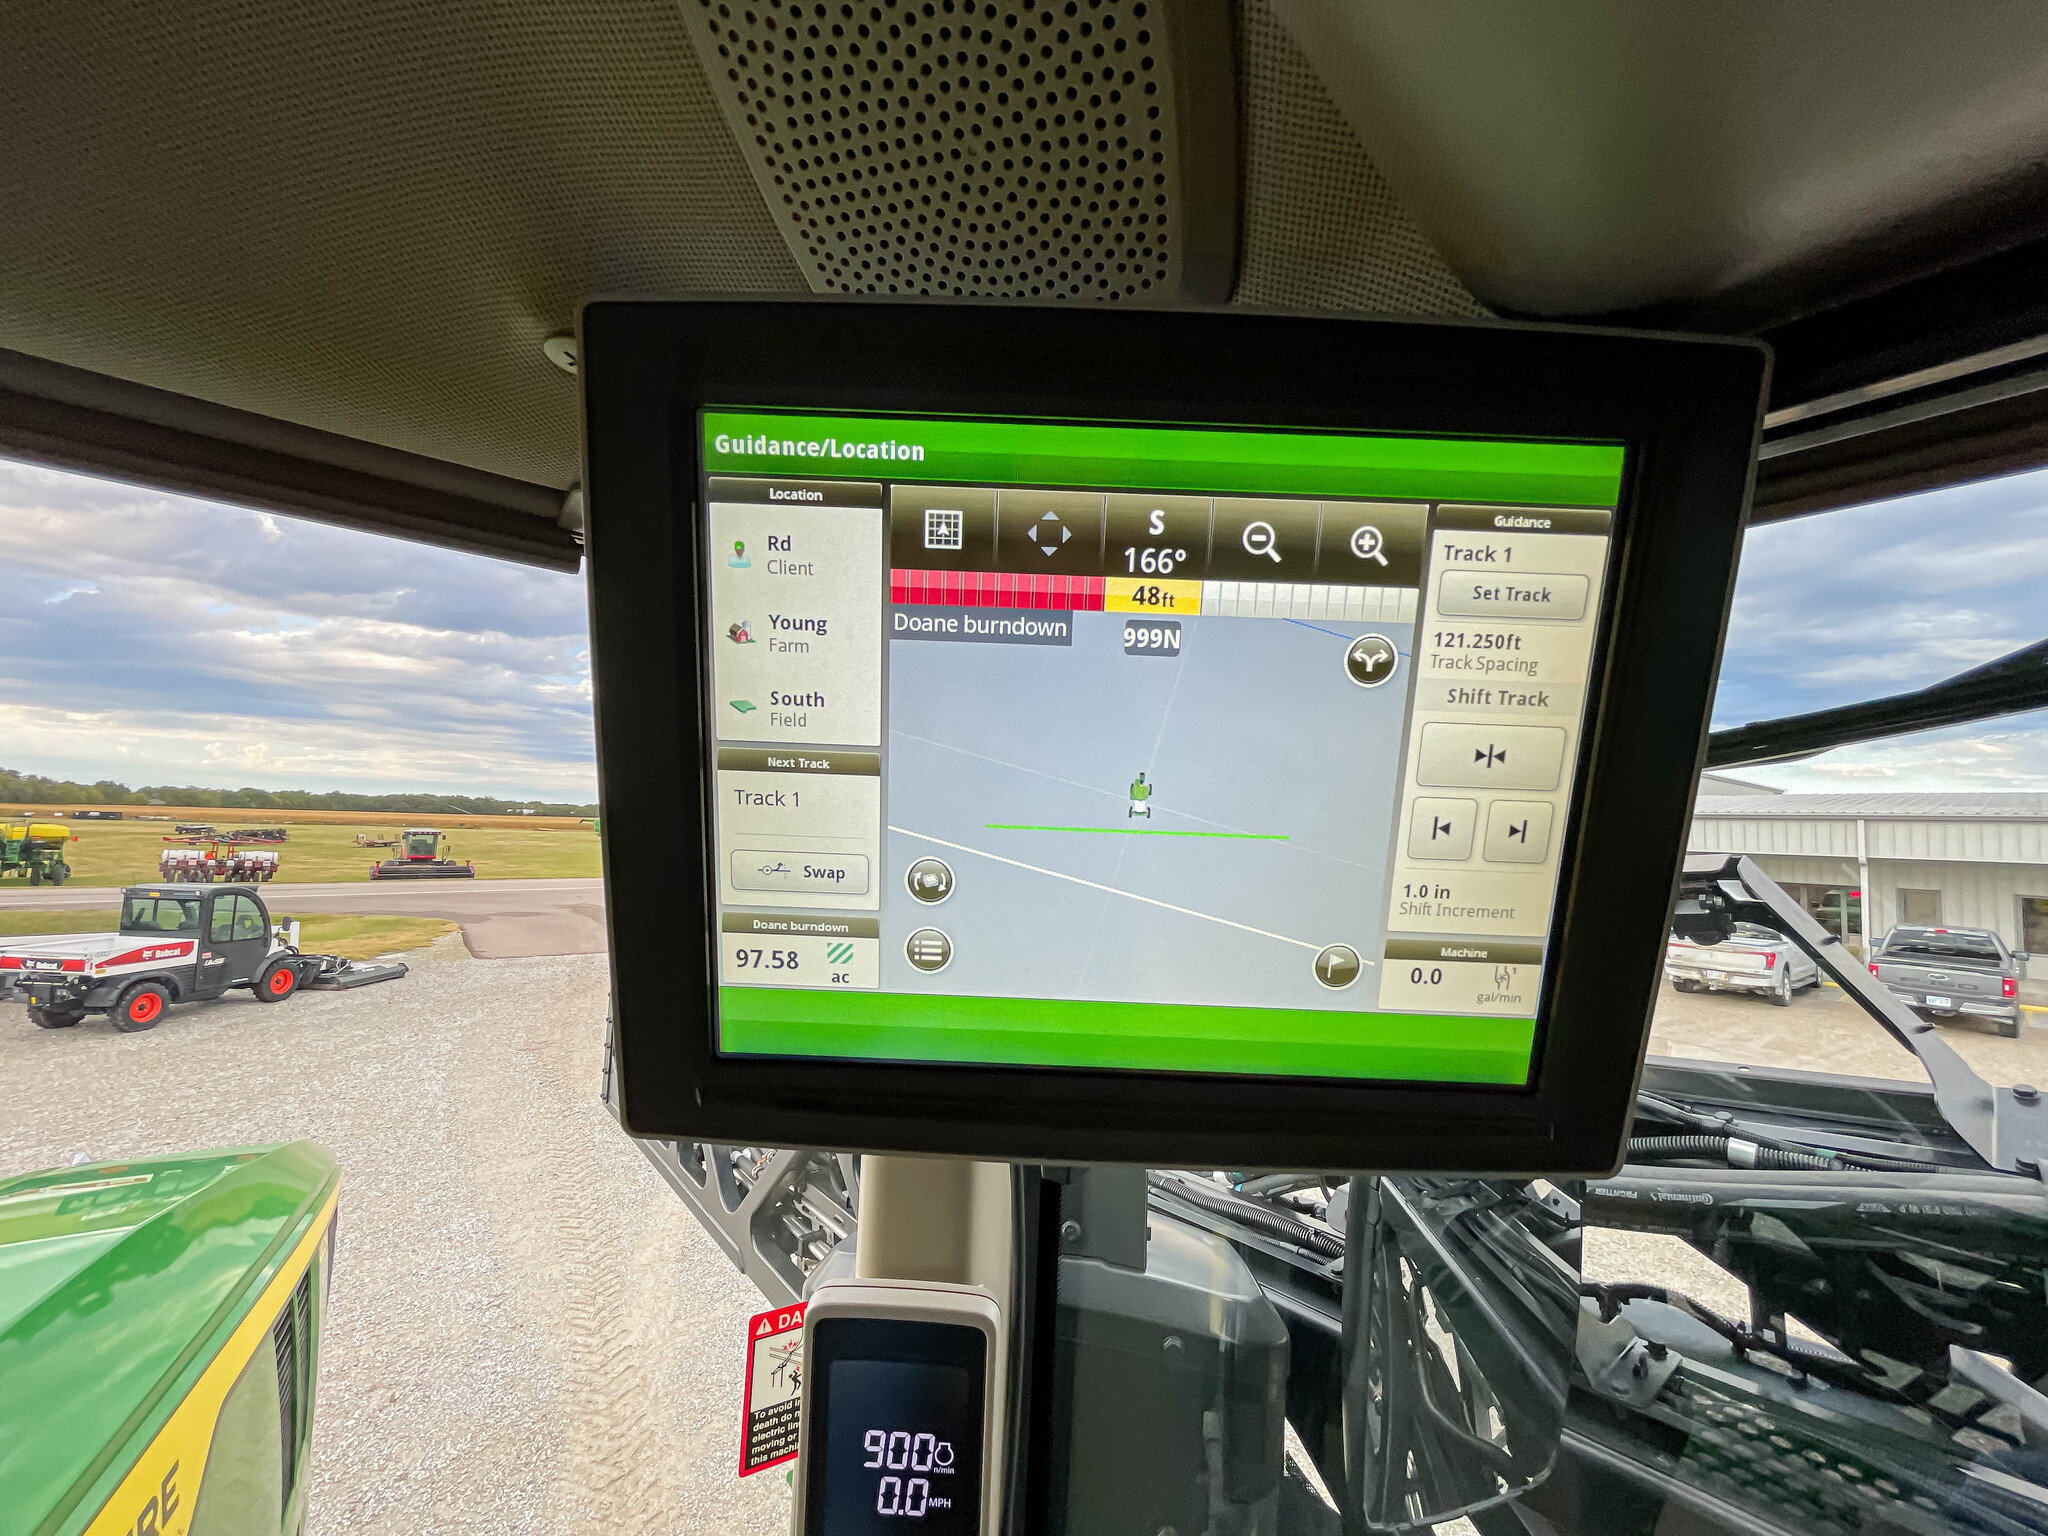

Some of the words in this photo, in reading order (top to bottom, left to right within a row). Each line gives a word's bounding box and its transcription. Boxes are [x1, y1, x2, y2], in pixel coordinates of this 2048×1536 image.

[714, 433, 925, 462] Guidance/Location
[769, 488, 823, 502] Location
[1148, 509, 1165, 536] S
[1494, 515, 1552, 530] Guidance
[768, 535, 792, 553] Rd
[1124, 547, 1186, 575] 166°
[1444, 544, 1497, 564] Track
[1504, 547, 1512, 563] 1
[767, 559, 814, 577] Client
[1473, 585, 1500, 601] Set
[1506, 586, 1552, 603] Track
[769, 614, 828, 636] Young
[894, 612, 959, 635] Doane
[964, 615, 1067, 638] burndown
[769, 638, 810, 655] Farm
[1124, 627, 1181, 651] 999N
[1434, 632, 1522, 651] 121.250ft
[1431, 654, 1473, 671] Track
[1475, 657, 1539, 677] Spacing
[770, 691, 825, 709] South
[1447, 688, 1492, 706] Shift
[1498, 690, 1550, 708] Track
[770, 712, 808, 729] Field
[768, 756, 795, 769] Next
[799, 758, 830, 770] Track
[734, 789, 786, 807] Track
[792, 791, 800, 807] 1
[803, 865, 846, 882] Swap
[1403, 884, 1428, 899] 1.0
[1434, 884, 1451, 900] in
[1399, 902, 1432, 917] Shift
[1436, 904, 1516, 920] Increment
[753, 919, 788, 932] Doane
[789, 920, 849, 934] burndown
[155, 948, 181, 959] Bobcat
[736, 949, 800, 970] 97.58
[1440, 947, 1488, 959] Machine
[831, 972, 850, 984] ac
[1411, 967, 1442, 985] 0.0
[1476, 991, 1522, 1004] gal/min
[778, 1310, 803, 1330] DA
[754, 1410, 766, 1420] To
[768, 1400, 793, 1416] avoid
[752, 1426, 786, 1443] electric
[787, 1421, 800, 1431] lin
[753, 1417, 779, 1432] death
[781, 1413, 793, 1422] do
[751, 1437, 786, 1455] moving
[787, 1433, 798, 1442] or
[863, 1430, 936, 1471] 900
[751, 1453, 768, 1466] this
[770, 1442, 799, 1458] machi
[126, 1458, 180, 1536] RE
[877, 1476, 929, 1517] 0.0
[929, 1497, 951, 1509] MPH
